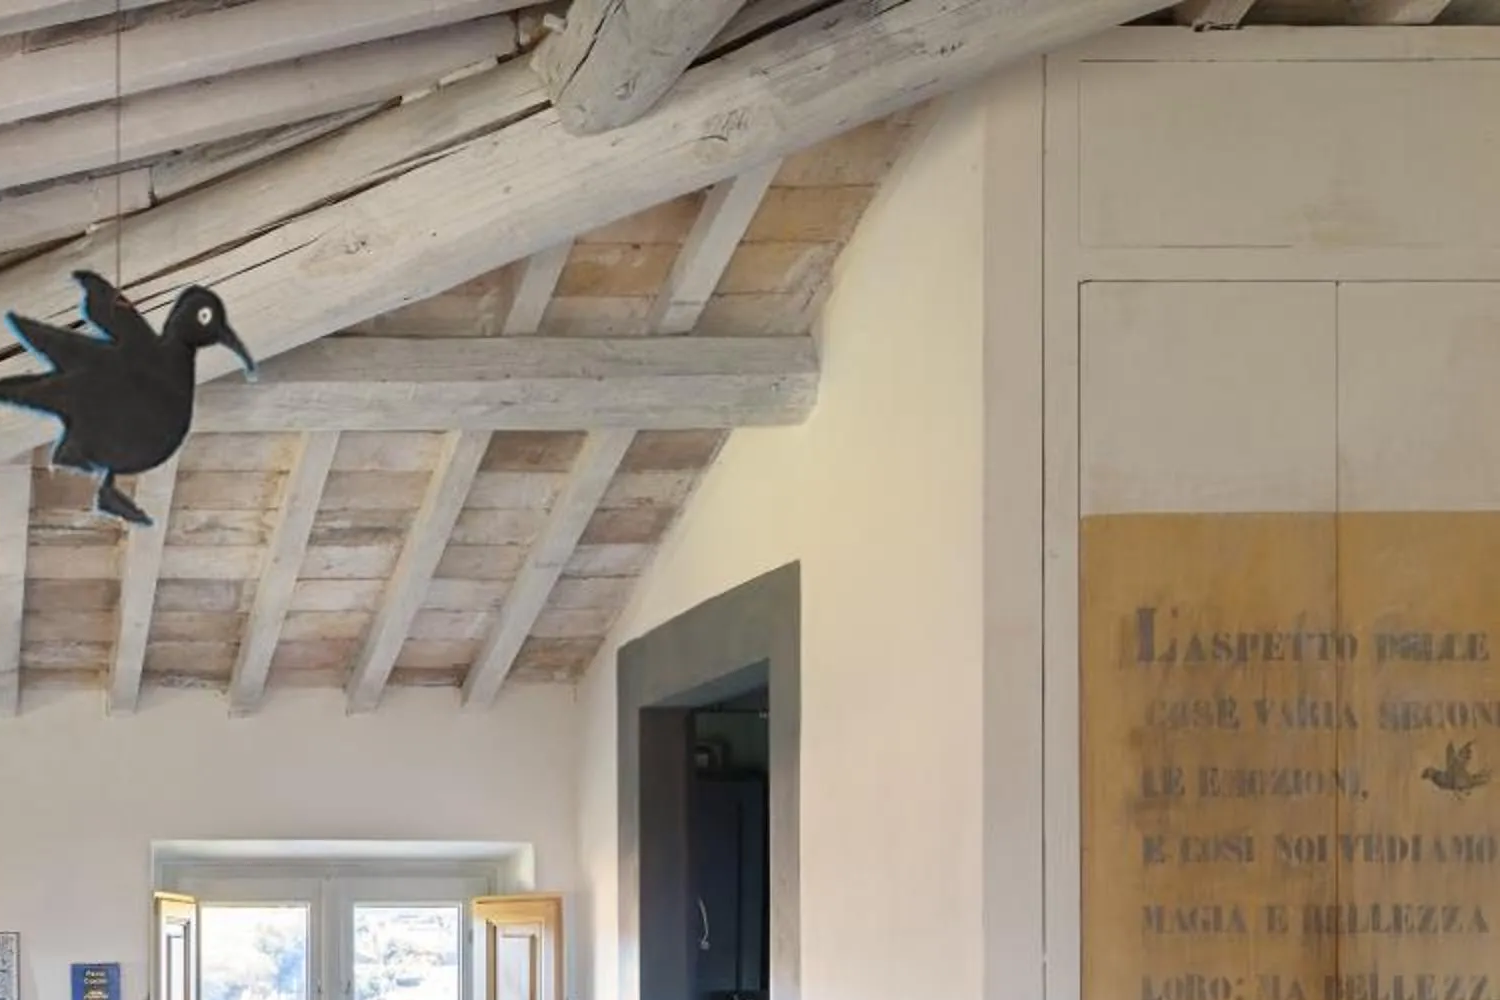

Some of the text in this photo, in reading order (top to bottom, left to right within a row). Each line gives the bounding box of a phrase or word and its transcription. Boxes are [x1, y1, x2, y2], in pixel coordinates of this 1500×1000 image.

[1275, 835, 1328, 864] NOI
[1338, 834, 1499, 864] VEDIAMO
[1143, 904, 1490, 935] MAGIA E BELLEZZA
